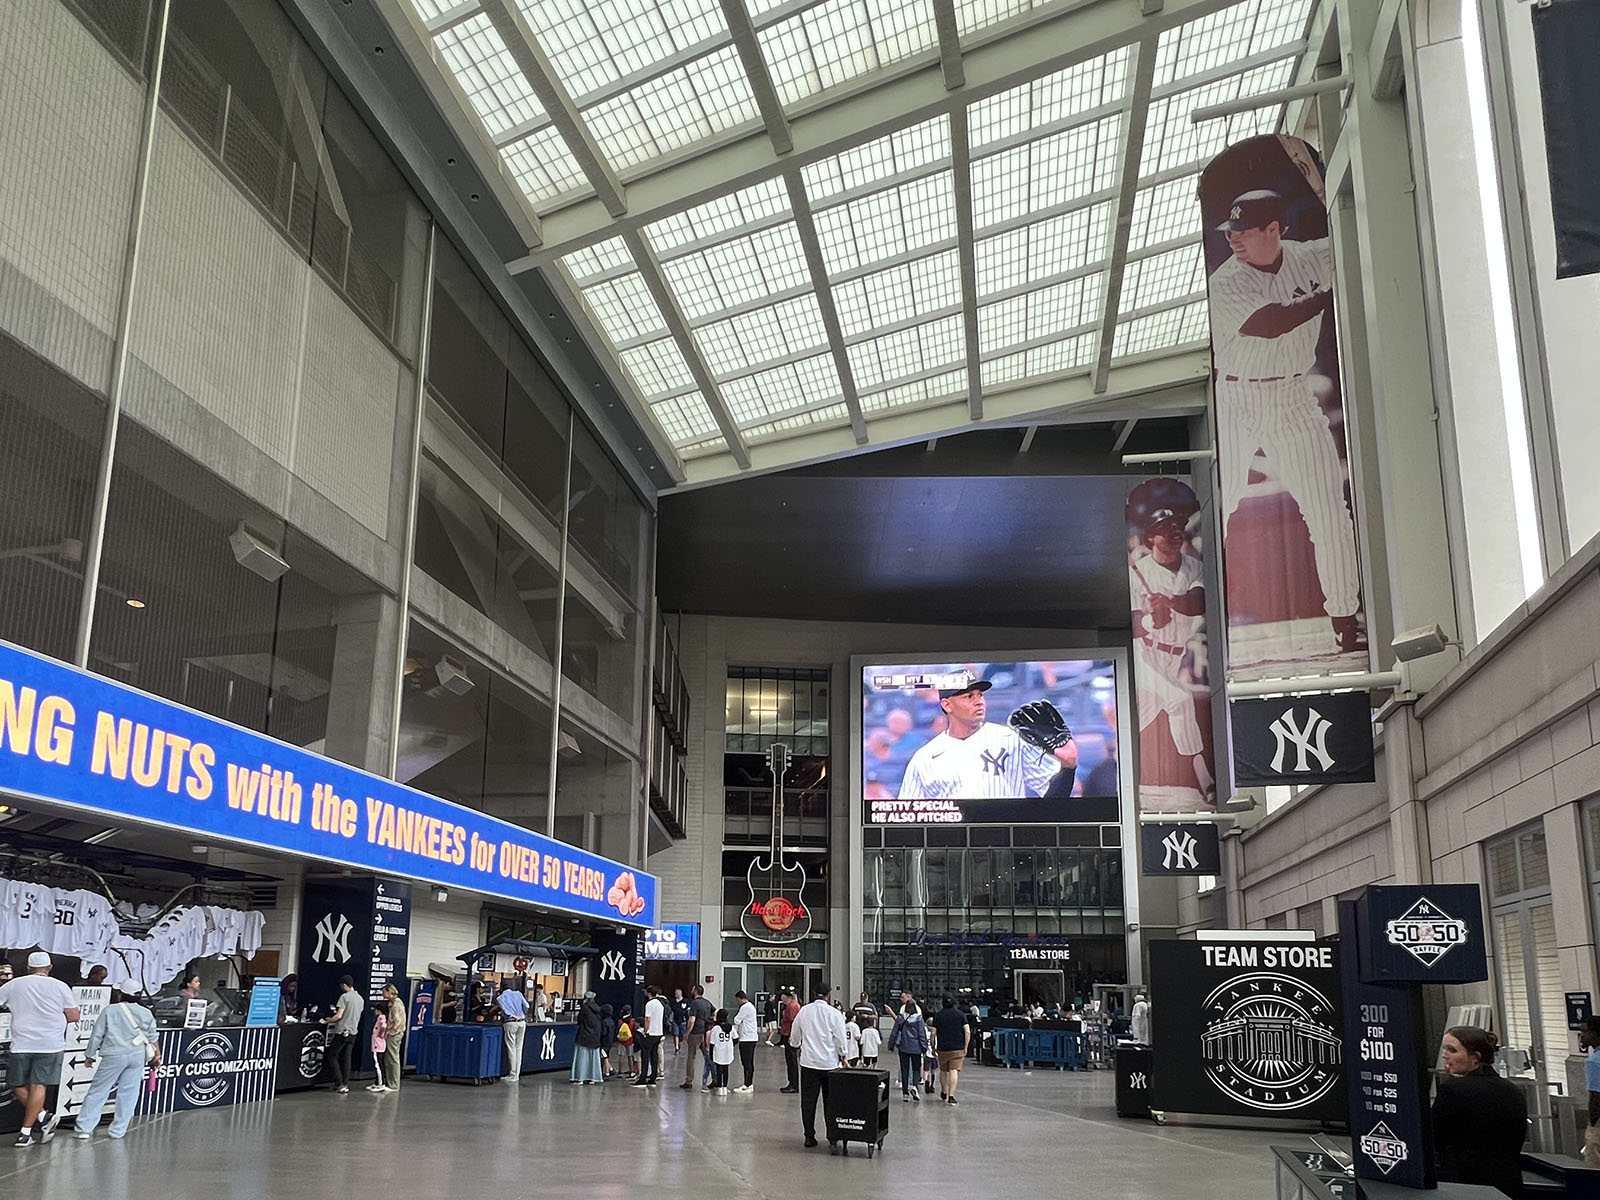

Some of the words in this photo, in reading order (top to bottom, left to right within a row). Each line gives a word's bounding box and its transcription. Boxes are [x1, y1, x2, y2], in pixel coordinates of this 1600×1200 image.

[1268, 707, 1336, 774] NY
[0, 678, 77, 766] NG
[91, 710, 216, 801] NUTS
[227, 762, 302, 824] with
[311, 783, 357, 838] the
[366, 797, 467, 866] YANKEES
[470, 831, 497, 873] for
[499, 840, 541, 885] OVER
[542, 854, 561, 891] 50
[563, 860, 606, 902] YEARS!
[871, 801, 911, 812] PRETTY
[912, 801, 960, 812] SPECIAL.
[871, 812, 887, 823] HE
[888, 812, 915, 823] ALSO
[917, 812, 963, 823] PITCHED
[1161, 830, 1200, 870] NY
[751, 902, 778, 916] Hard
[780, 903, 806, 919] Rock
[311, 912, 354, 965] NY
[653, 929, 676, 942] TO
[1394, 925, 1420, 942] 50
[1432, 925, 1459, 942] 50
[752, 949, 769, 958] NYY
[771, 949, 796, 959] STEAK
[1009, 948, 1038, 959] TEAM
[1039, 950, 1070, 960] STORE
[1201, 946, 1257, 968] TEAM
[1263, 946, 1333, 968] STORE
[599, 950, 627, 981] NY
[81, 989, 102, 1000] MAIN
[1214, 982, 1322, 1015] YANKEE
[79, 1004, 100, 1016] TEAM
[1360, 1004, 1389, 1023] 300
[74, 1019, 95, 1031] STOR
[1367, 1026, 1384, 1038] FOR
[719, 1032, 730, 1043] 99
[1360, 1038, 1394, 1061] $100
[143, 1063, 184, 1079] ESEY
[185, 1058, 273, 1076] CUSTOMIZATION
[1215, 1064, 1327, 1101] STADIUM
[1384, 1072, 1398, 1083] $50
[1383, 1087, 1397, 1098] $25
[1384, 1102, 1397, 1113] $10
[1365, 1140, 1380, 1154] 50
[1388, 1143, 1403, 1158] 50
